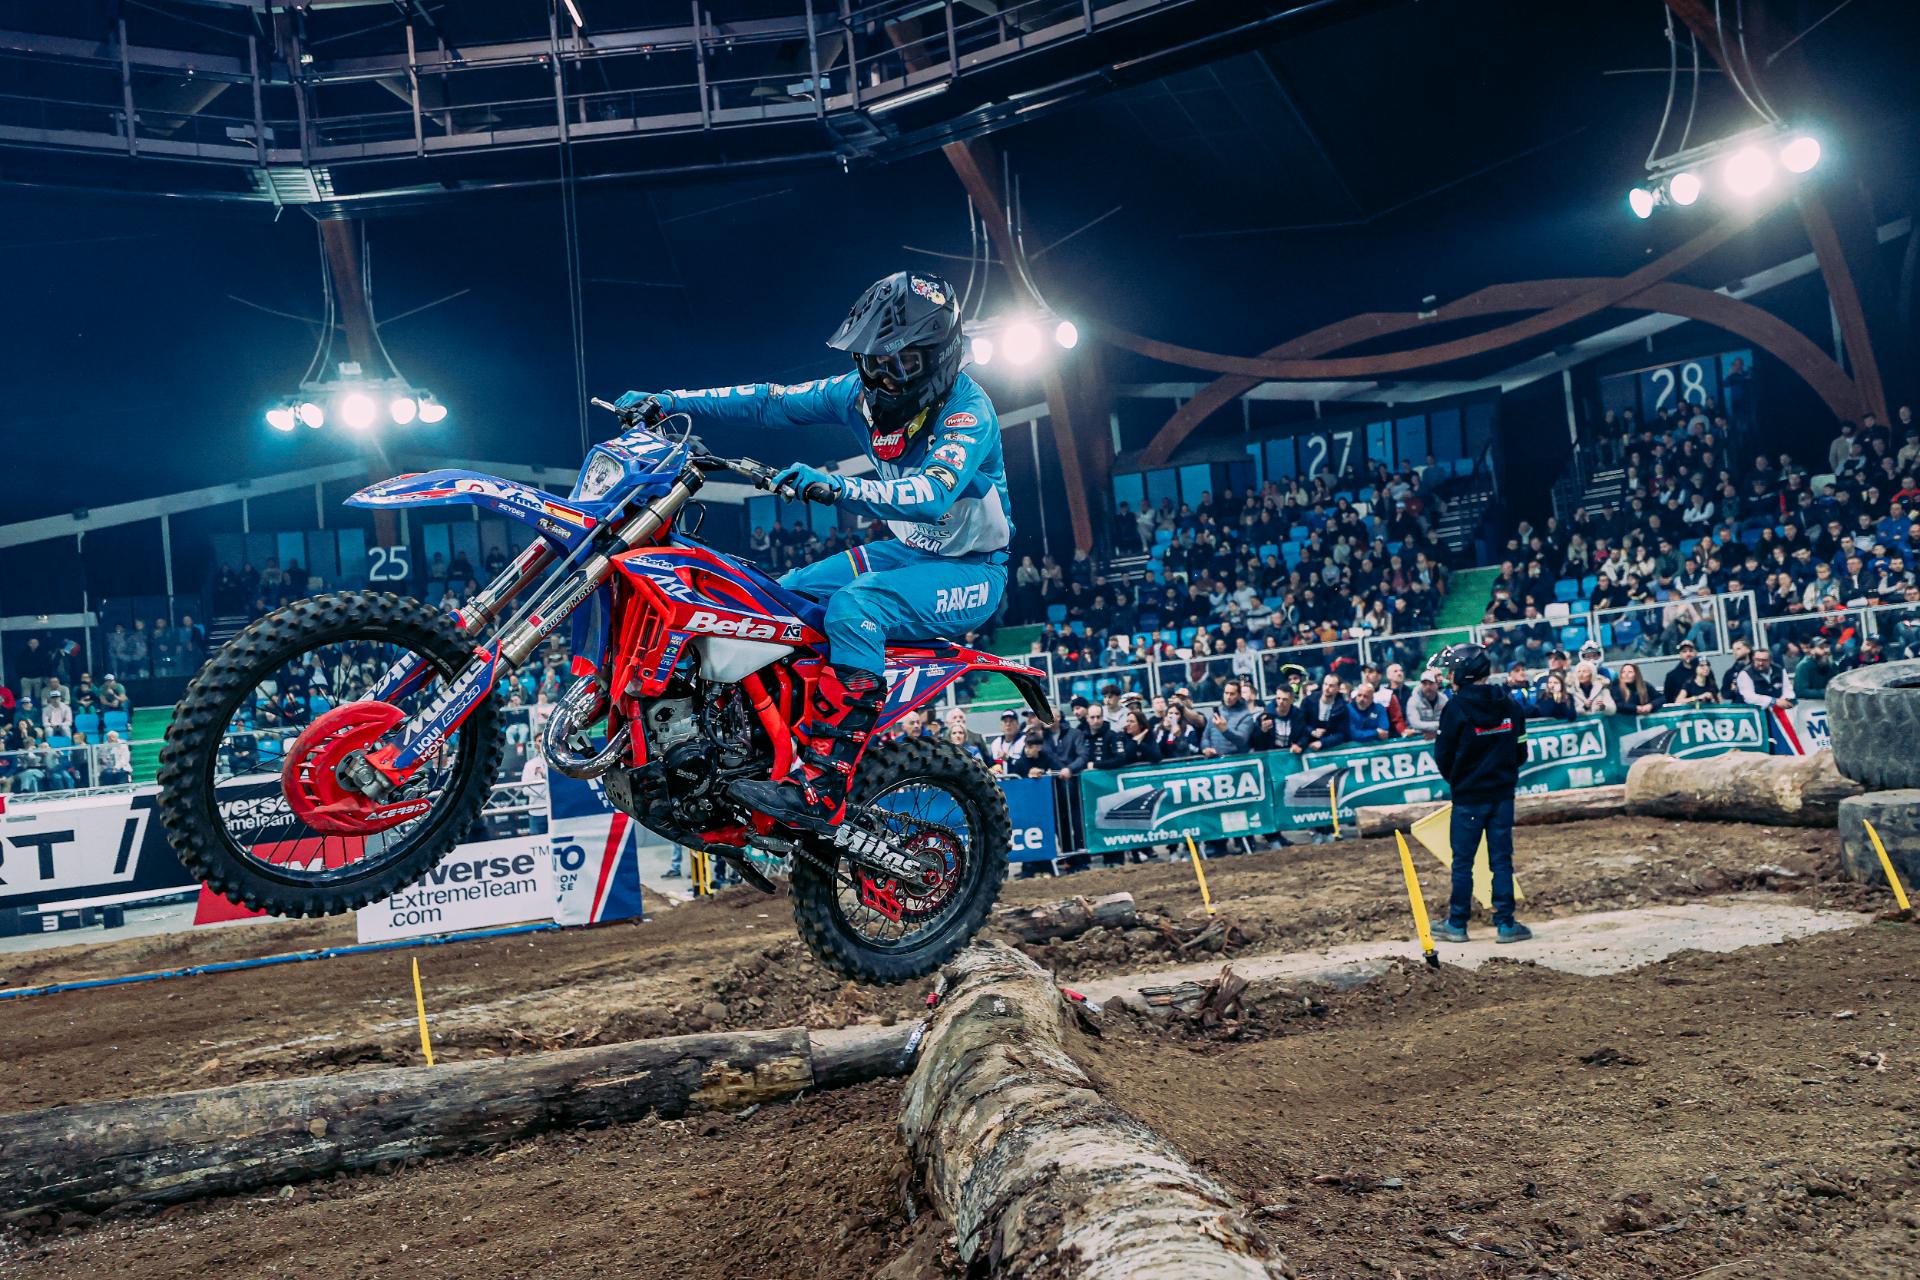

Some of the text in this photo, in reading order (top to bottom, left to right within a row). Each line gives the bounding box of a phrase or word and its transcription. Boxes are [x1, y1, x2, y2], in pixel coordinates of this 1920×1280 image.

[1651, 363, 1707, 415] 28
[873, 434, 903, 447] LEATT
[1308, 431, 1353, 482] 27
[843, 475, 934, 505] RAVEN
[908, 530, 942, 553] LIQUI
[368, 546, 408, 581] 25
[935, 580, 989, 613] RAVEN
[540, 604, 571, 637] Fauser
[682, 611, 776, 639] Beta
[442, 685, 481, 727] Beta
[412, 726, 443, 755] LIQUI
[1526, 731, 1602, 762] TRBA
[1675, 718, 1758, 744] TRBA
[420, 734, 446, 761] MOLY
[1347, 751, 1440, 784] TRBA
[1163, 771, 1259, 805] TRBA
[834, 824, 921, 878] Mitas
[1104, 827, 1200, 847] www.trba.eu
[389, 878, 537, 911] ExtremeTeam
[389, 907, 442, 928] .com
